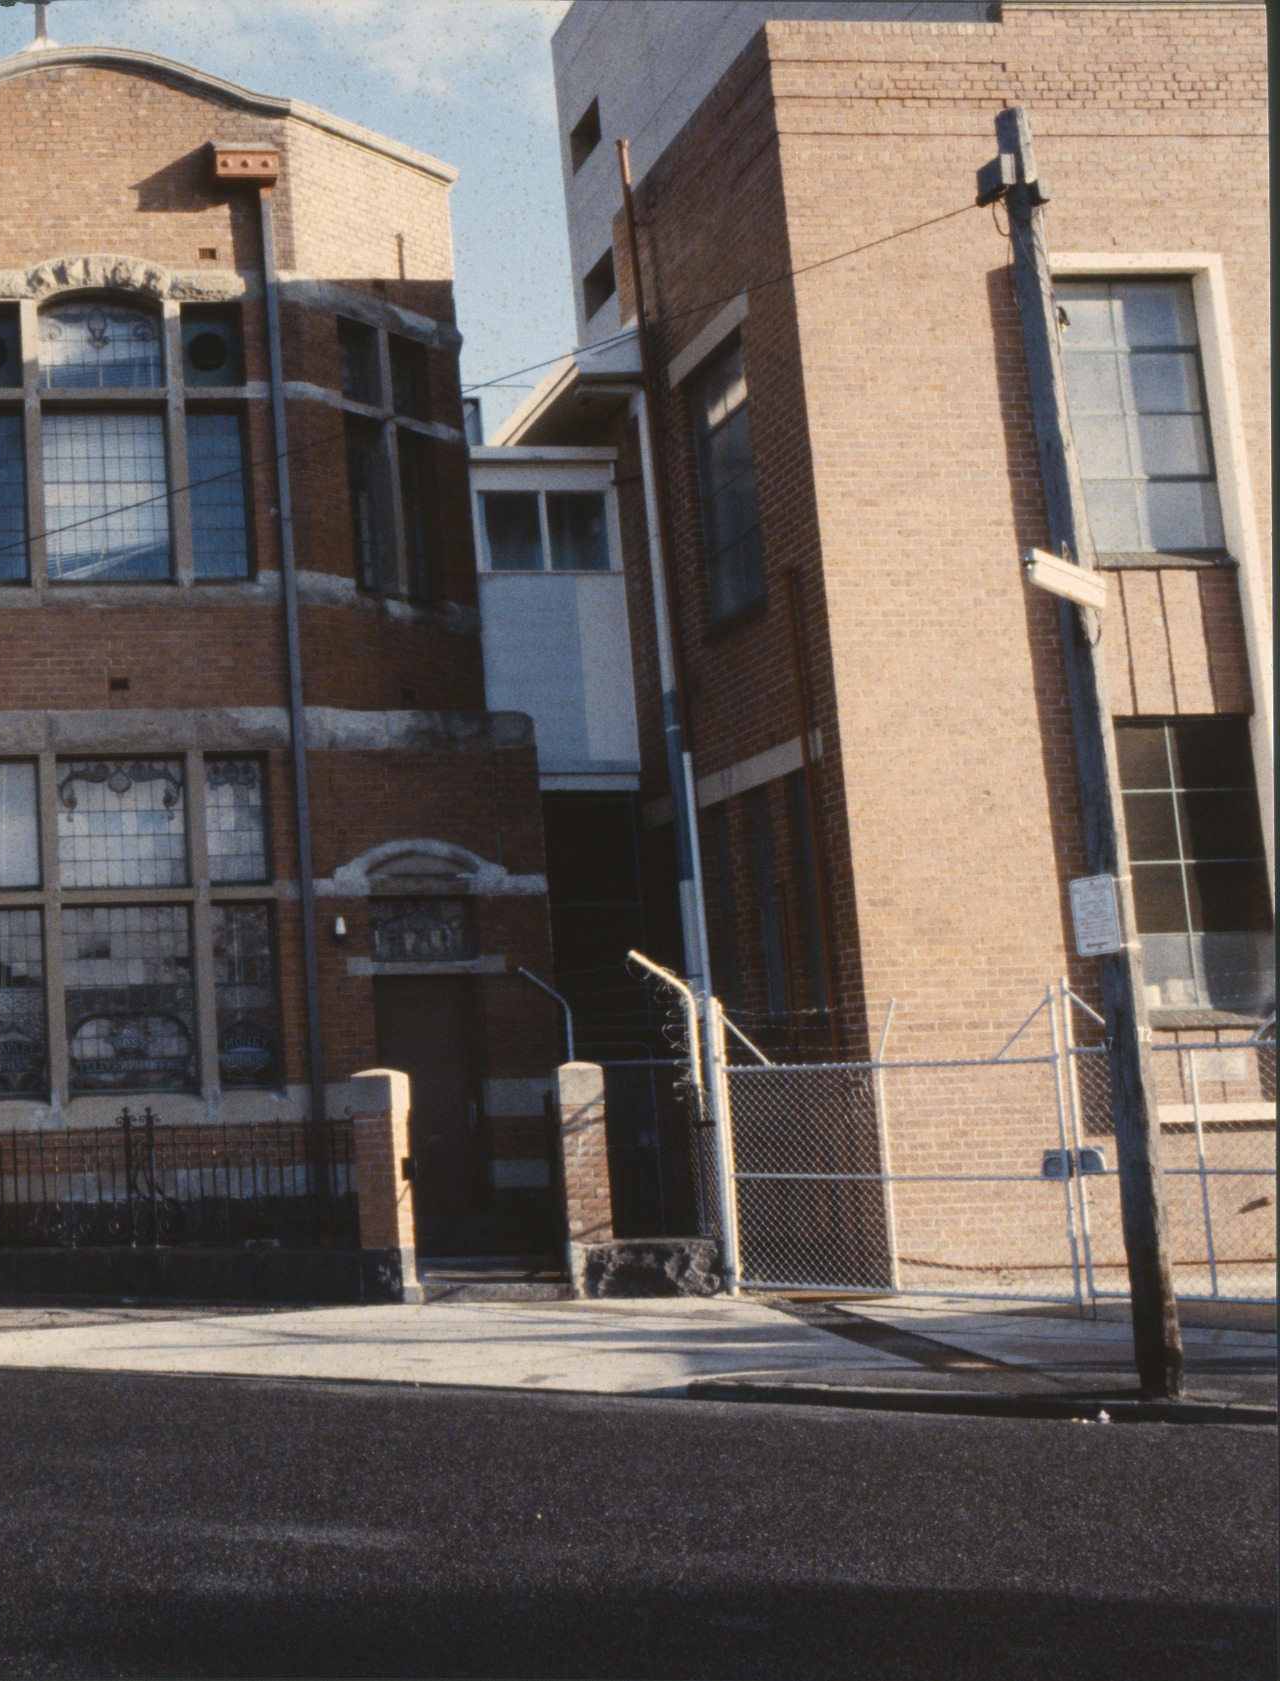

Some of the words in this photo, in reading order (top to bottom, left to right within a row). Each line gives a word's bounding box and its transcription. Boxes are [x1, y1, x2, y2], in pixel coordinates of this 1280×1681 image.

[223, 1034, 270, 1050] MONEY
[77, 1059, 143, 1073] TELEGRAPH
[222, 1051, 272, 1066] ORDERS
